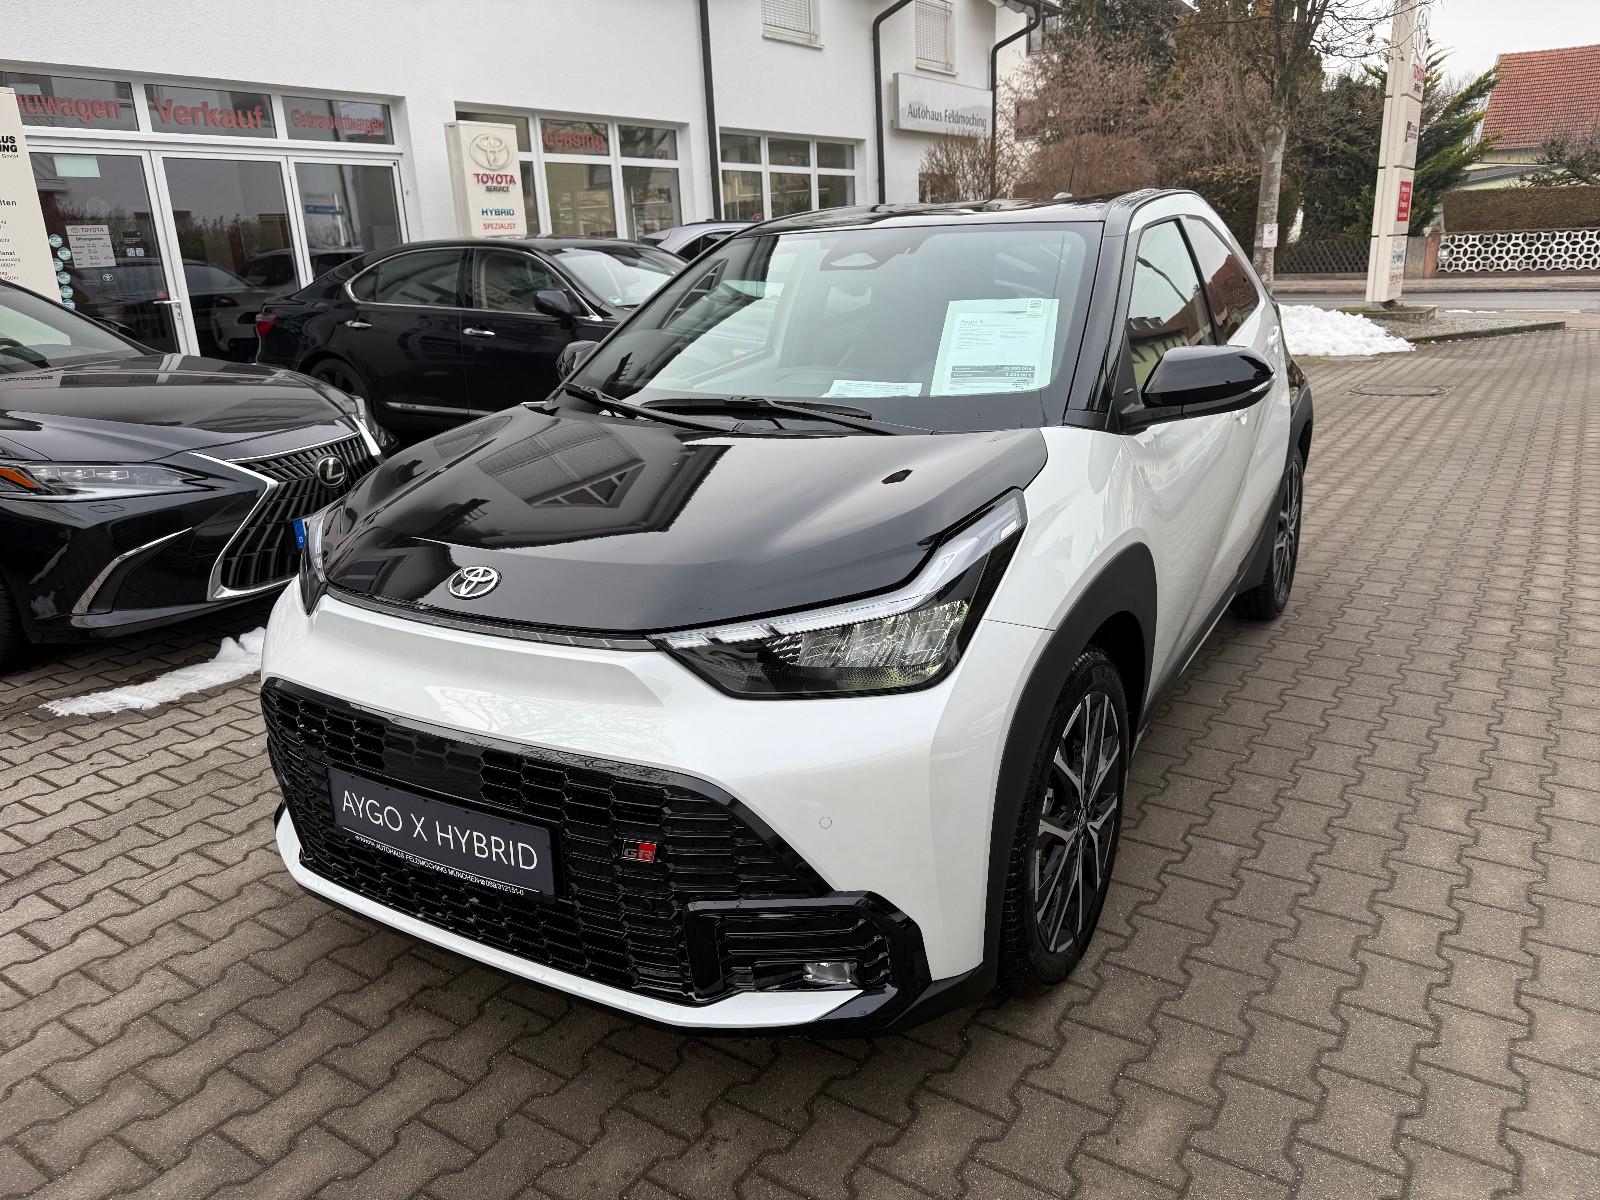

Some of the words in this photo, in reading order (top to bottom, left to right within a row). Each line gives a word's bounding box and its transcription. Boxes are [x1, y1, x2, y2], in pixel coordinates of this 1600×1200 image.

[153, 96, 263, 129] Verkauf
[907, 103, 943, 123] Autohaus
[944, 108, 987, 132] Feldmoching
[544, 129, 606, 151] Leasing
[473, 173, 516, 185] TOYOTA
[481, 207, 515, 217] HYBRID
[483, 222, 516, 230] SPEZIALIST
[342, 790, 402, 831] AYGO
[411, 813, 428, 842] X
[436, 821, 538, 871] HYBRID
[376, 842, 405, 859] AUTOHAUS
[405, 853, 448, 874] FELDMOCHING
[624, 847, 653, 859] GR
